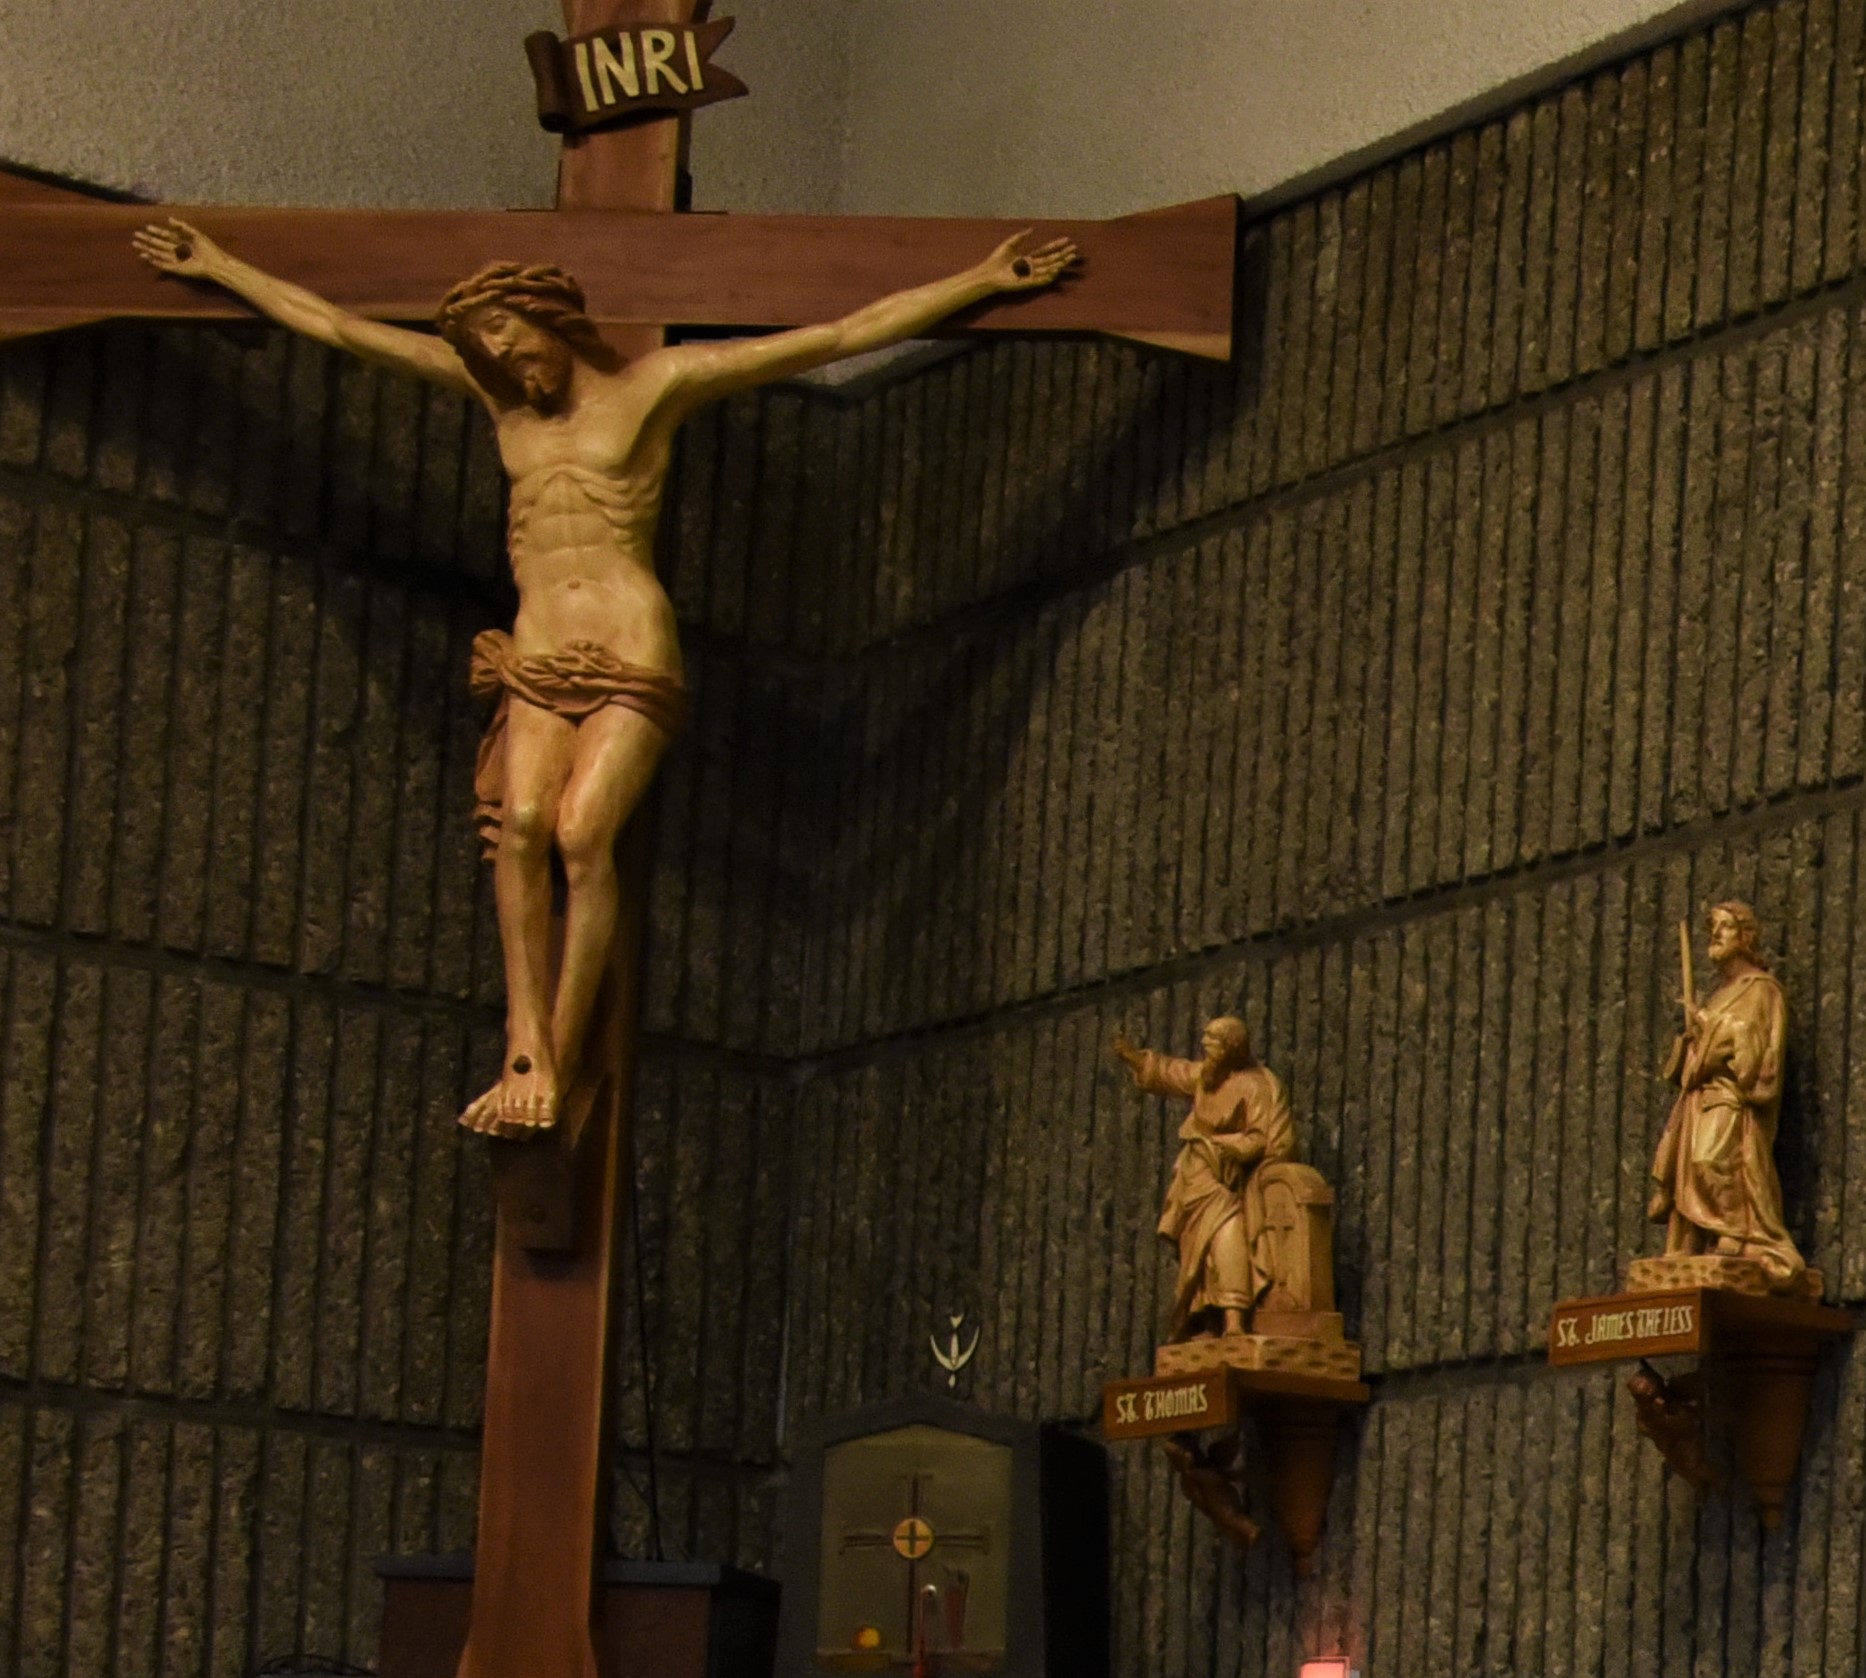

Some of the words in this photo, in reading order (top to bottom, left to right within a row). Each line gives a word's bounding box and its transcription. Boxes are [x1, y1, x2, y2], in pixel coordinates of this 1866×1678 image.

[574, 29, 704, 112] INRI
[1556, 1317, 1581, 1347] ST.
[1584, 1311, 1635, 1345] JAMES
[1636, 1307, 1664, 1338] THE
[1663, 1305, 1694, 1335] LESS
[1143, 1383, 1208, 1421] THOMAS
